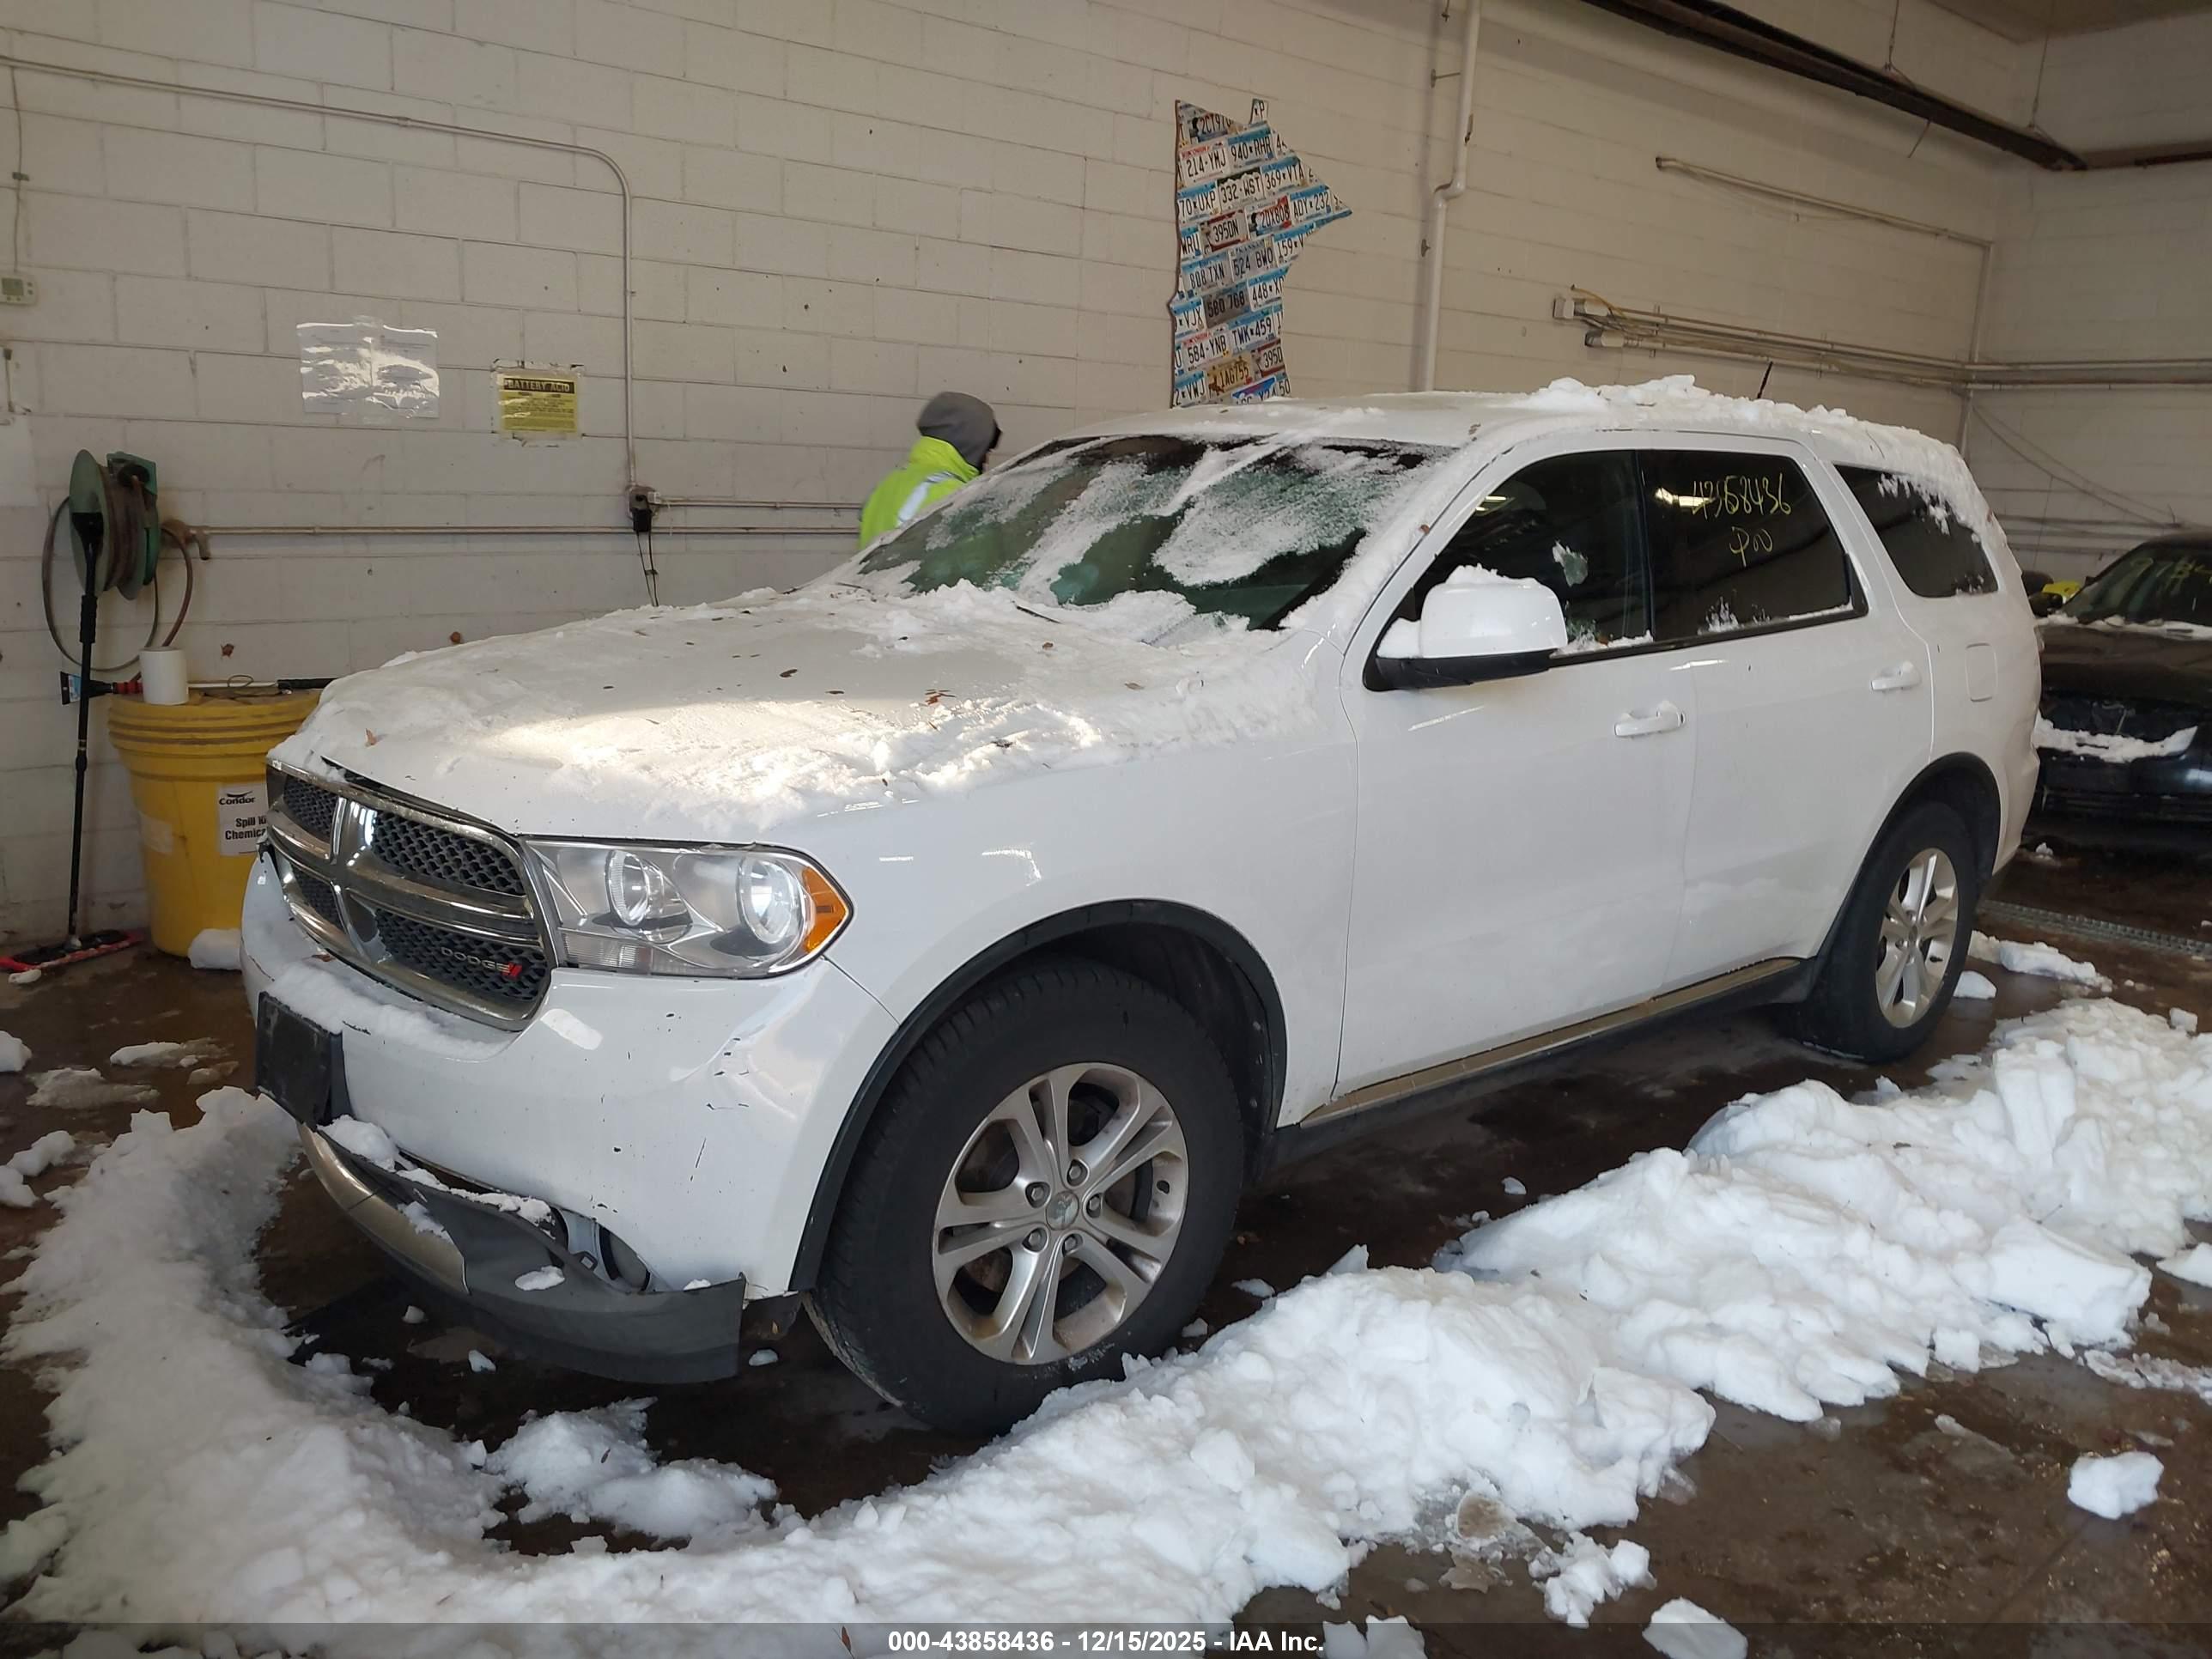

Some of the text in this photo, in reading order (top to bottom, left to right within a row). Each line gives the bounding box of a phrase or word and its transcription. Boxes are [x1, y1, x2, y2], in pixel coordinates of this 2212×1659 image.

[507, 379, 570, 392] BATTERY ACID
[219, 796, 255, 805] Condor
[235, 817, 256, 829] Spill
[441, 946, 510, 974] DODGE
